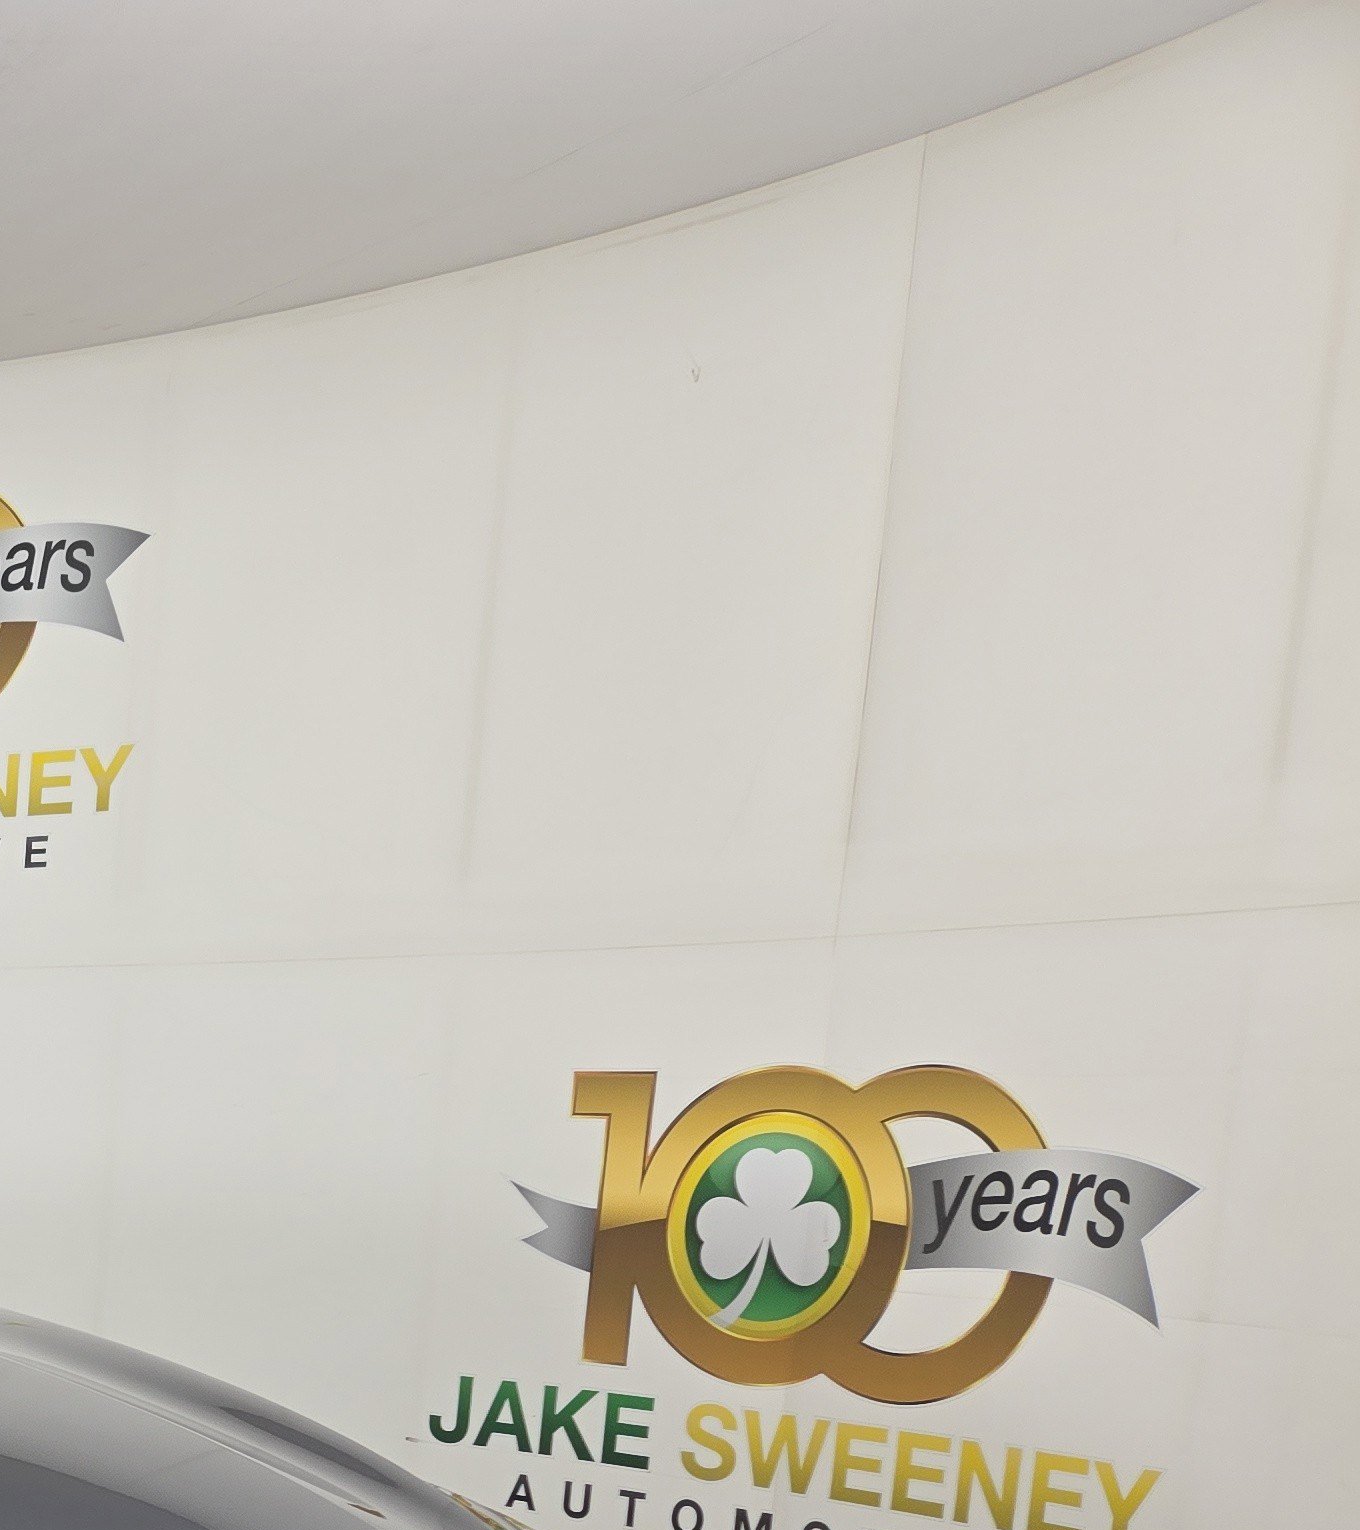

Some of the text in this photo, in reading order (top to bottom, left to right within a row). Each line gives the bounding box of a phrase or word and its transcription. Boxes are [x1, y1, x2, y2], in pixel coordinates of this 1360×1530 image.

[571, 1064, 1131, 1406] 100 years
[428, 1375, 655, 1471] JAKE
